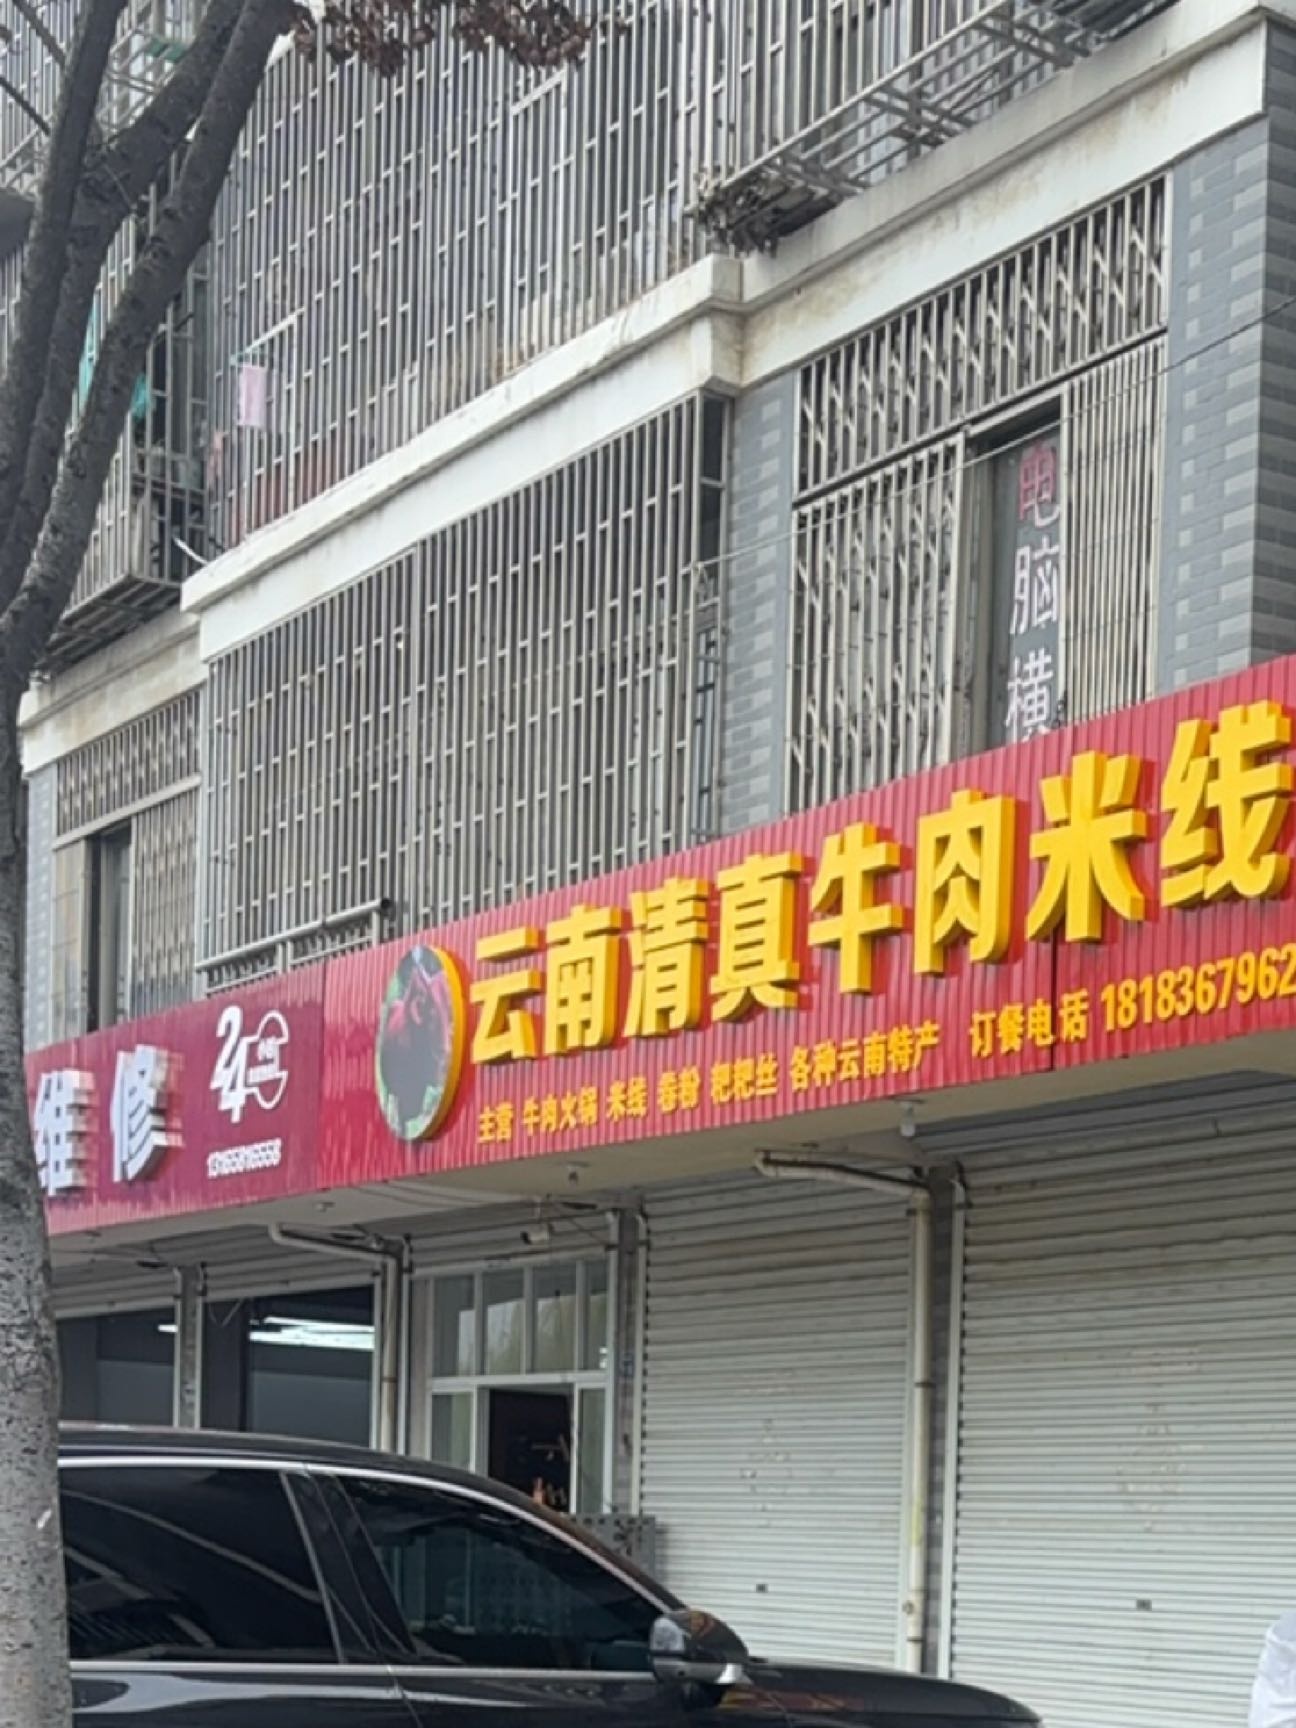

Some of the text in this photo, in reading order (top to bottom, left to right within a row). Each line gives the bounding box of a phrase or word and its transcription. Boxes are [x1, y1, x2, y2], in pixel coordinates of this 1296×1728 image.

[478, 1103, 514, 1144] 主营
[523, 1083, 598, 1137] 牛肉火锅
[606, 1075, 649, 1123] 米线
[657, 1065, 701, 1114] 卷粉
[790, 1019, 941, 1092] 各种云南特产
[969, 989, 1090, 1059] 订餐电话
